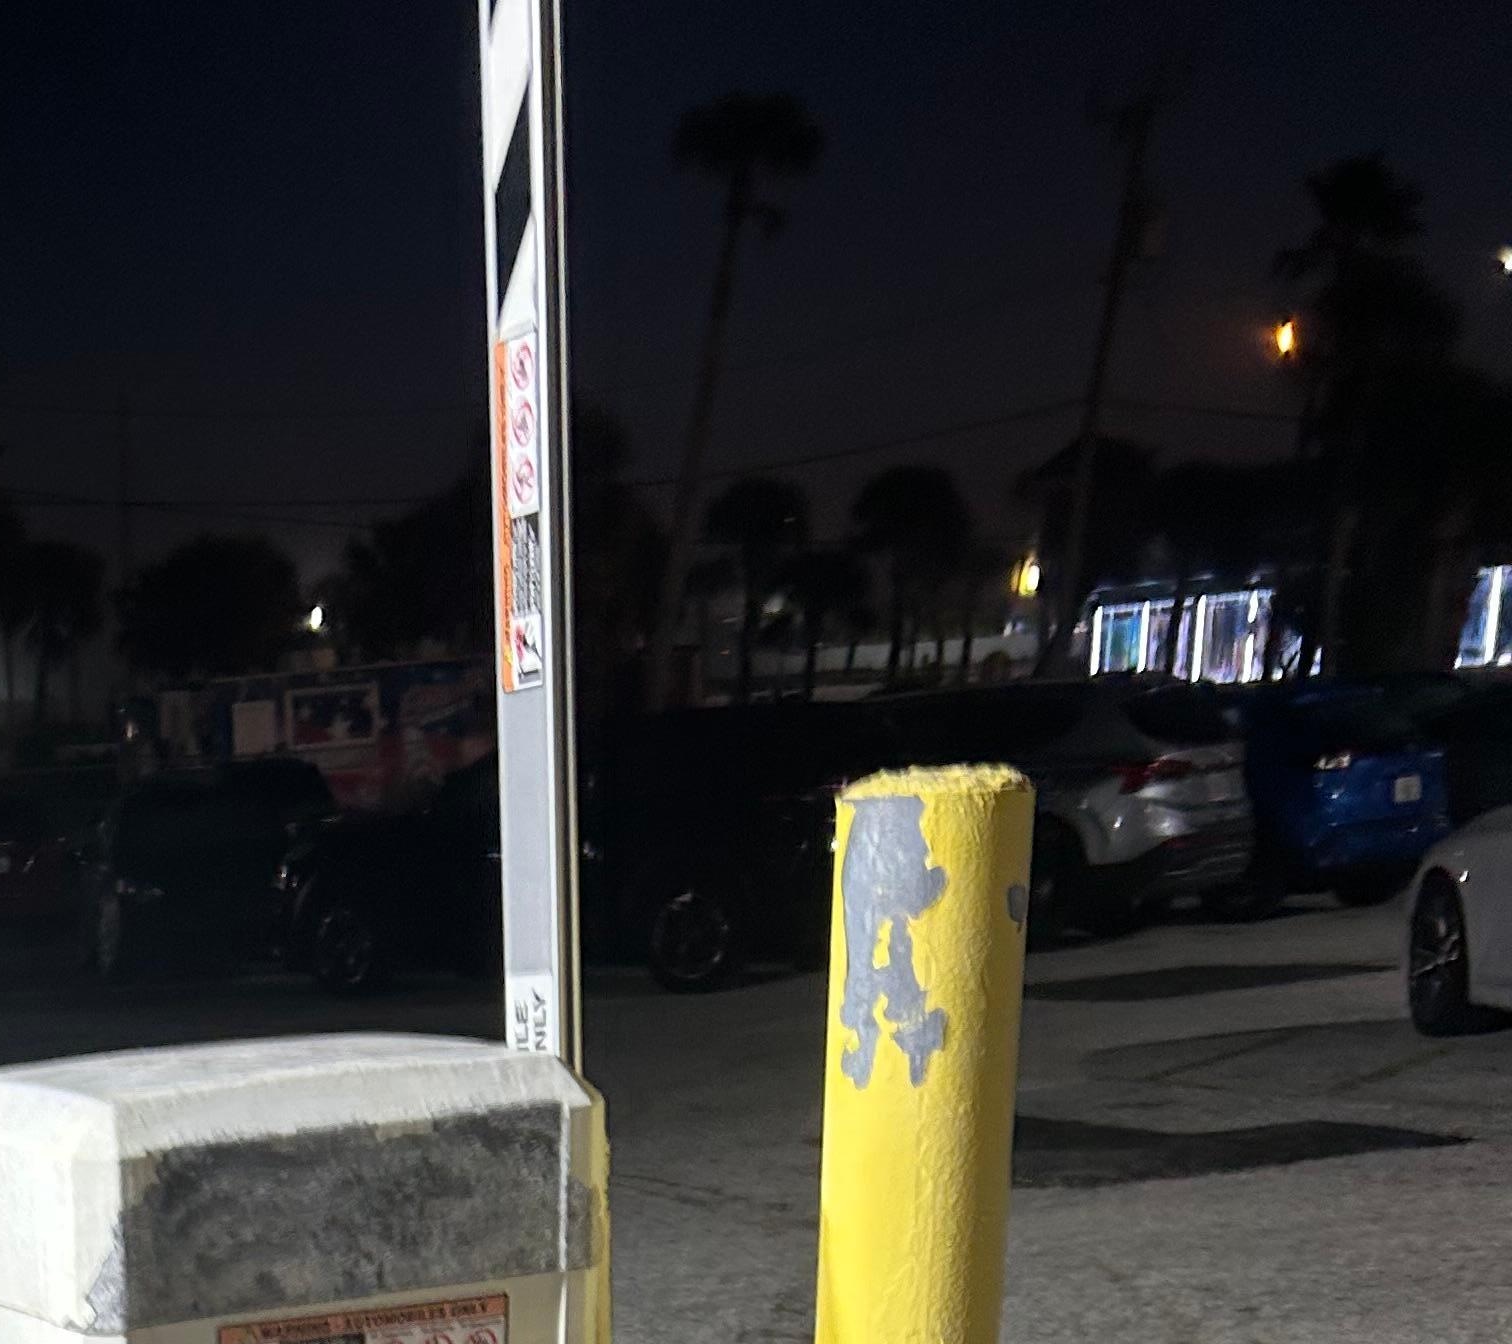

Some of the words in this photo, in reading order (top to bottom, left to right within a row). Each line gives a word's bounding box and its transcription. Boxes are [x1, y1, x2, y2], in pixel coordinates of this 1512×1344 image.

[532, 986, 547, 1051] NLY
[345, 1303, 446, 1330] AUTOMOBILES
[451, 1300, 487, 1317] ONLY
